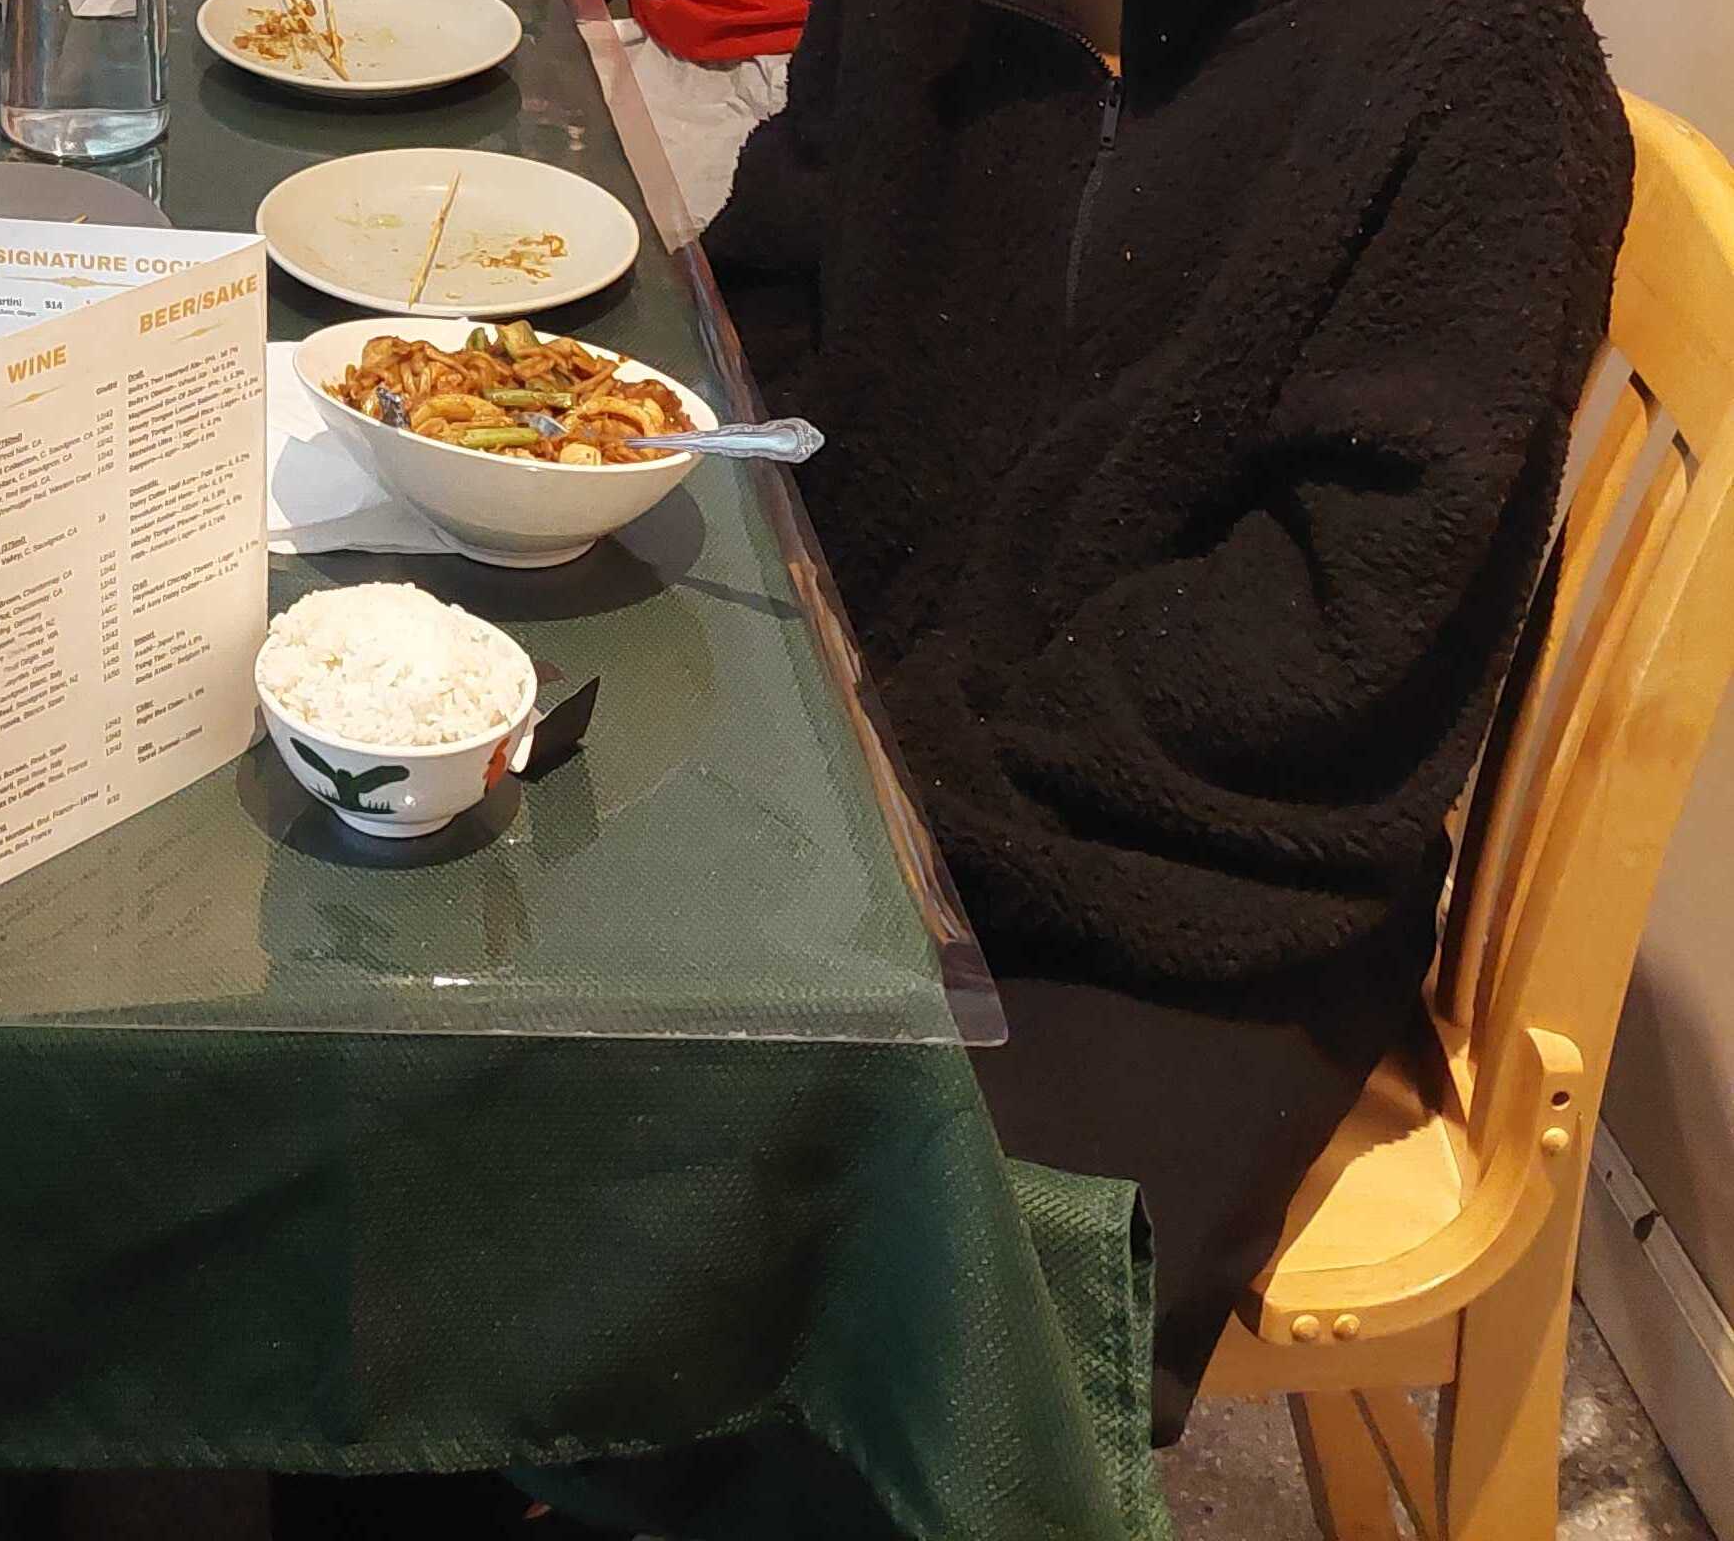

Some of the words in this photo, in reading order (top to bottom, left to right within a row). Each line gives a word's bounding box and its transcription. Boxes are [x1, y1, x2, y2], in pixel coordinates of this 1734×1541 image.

[44, 300, 63, 310] $14
[139, 274, 258, 334] BEER/SAKE
[7, 344, 67, 384] WINE
